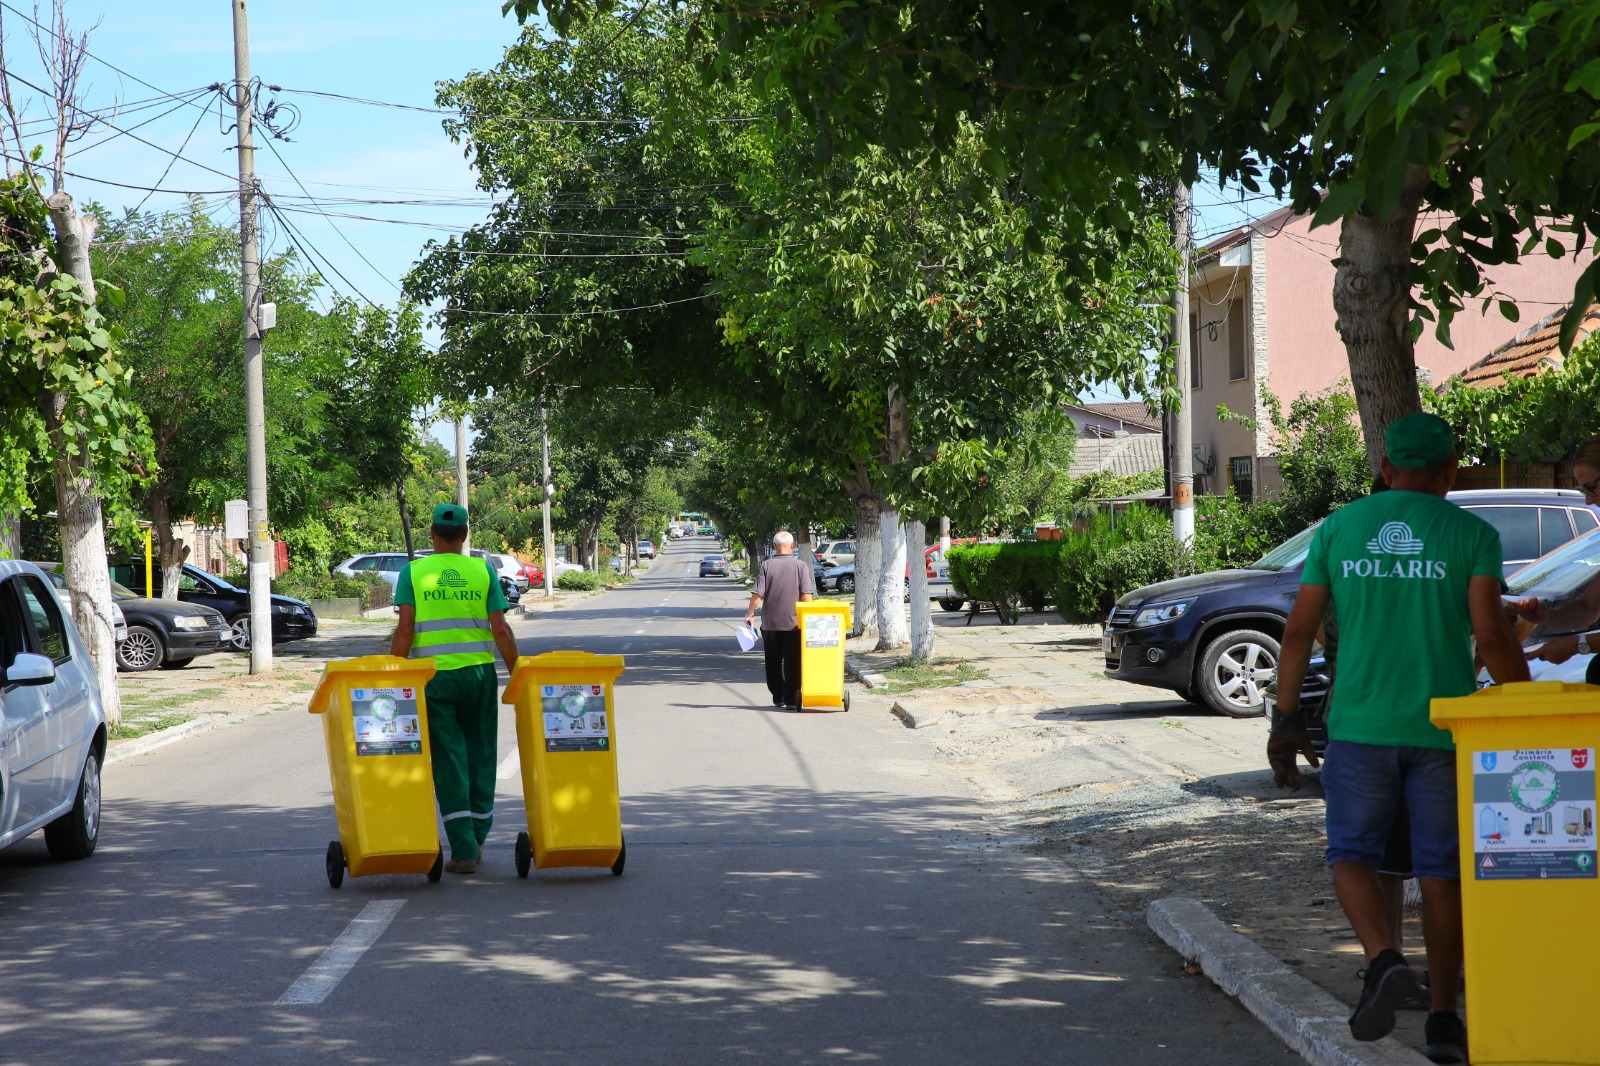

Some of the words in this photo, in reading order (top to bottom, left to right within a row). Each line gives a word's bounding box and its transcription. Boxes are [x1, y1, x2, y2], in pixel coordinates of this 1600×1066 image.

[1341, 558, 1447, 580] POLARIS
[423, 589, 482, 601] POLARIS
[1572, 755, 1587, 763] CT
